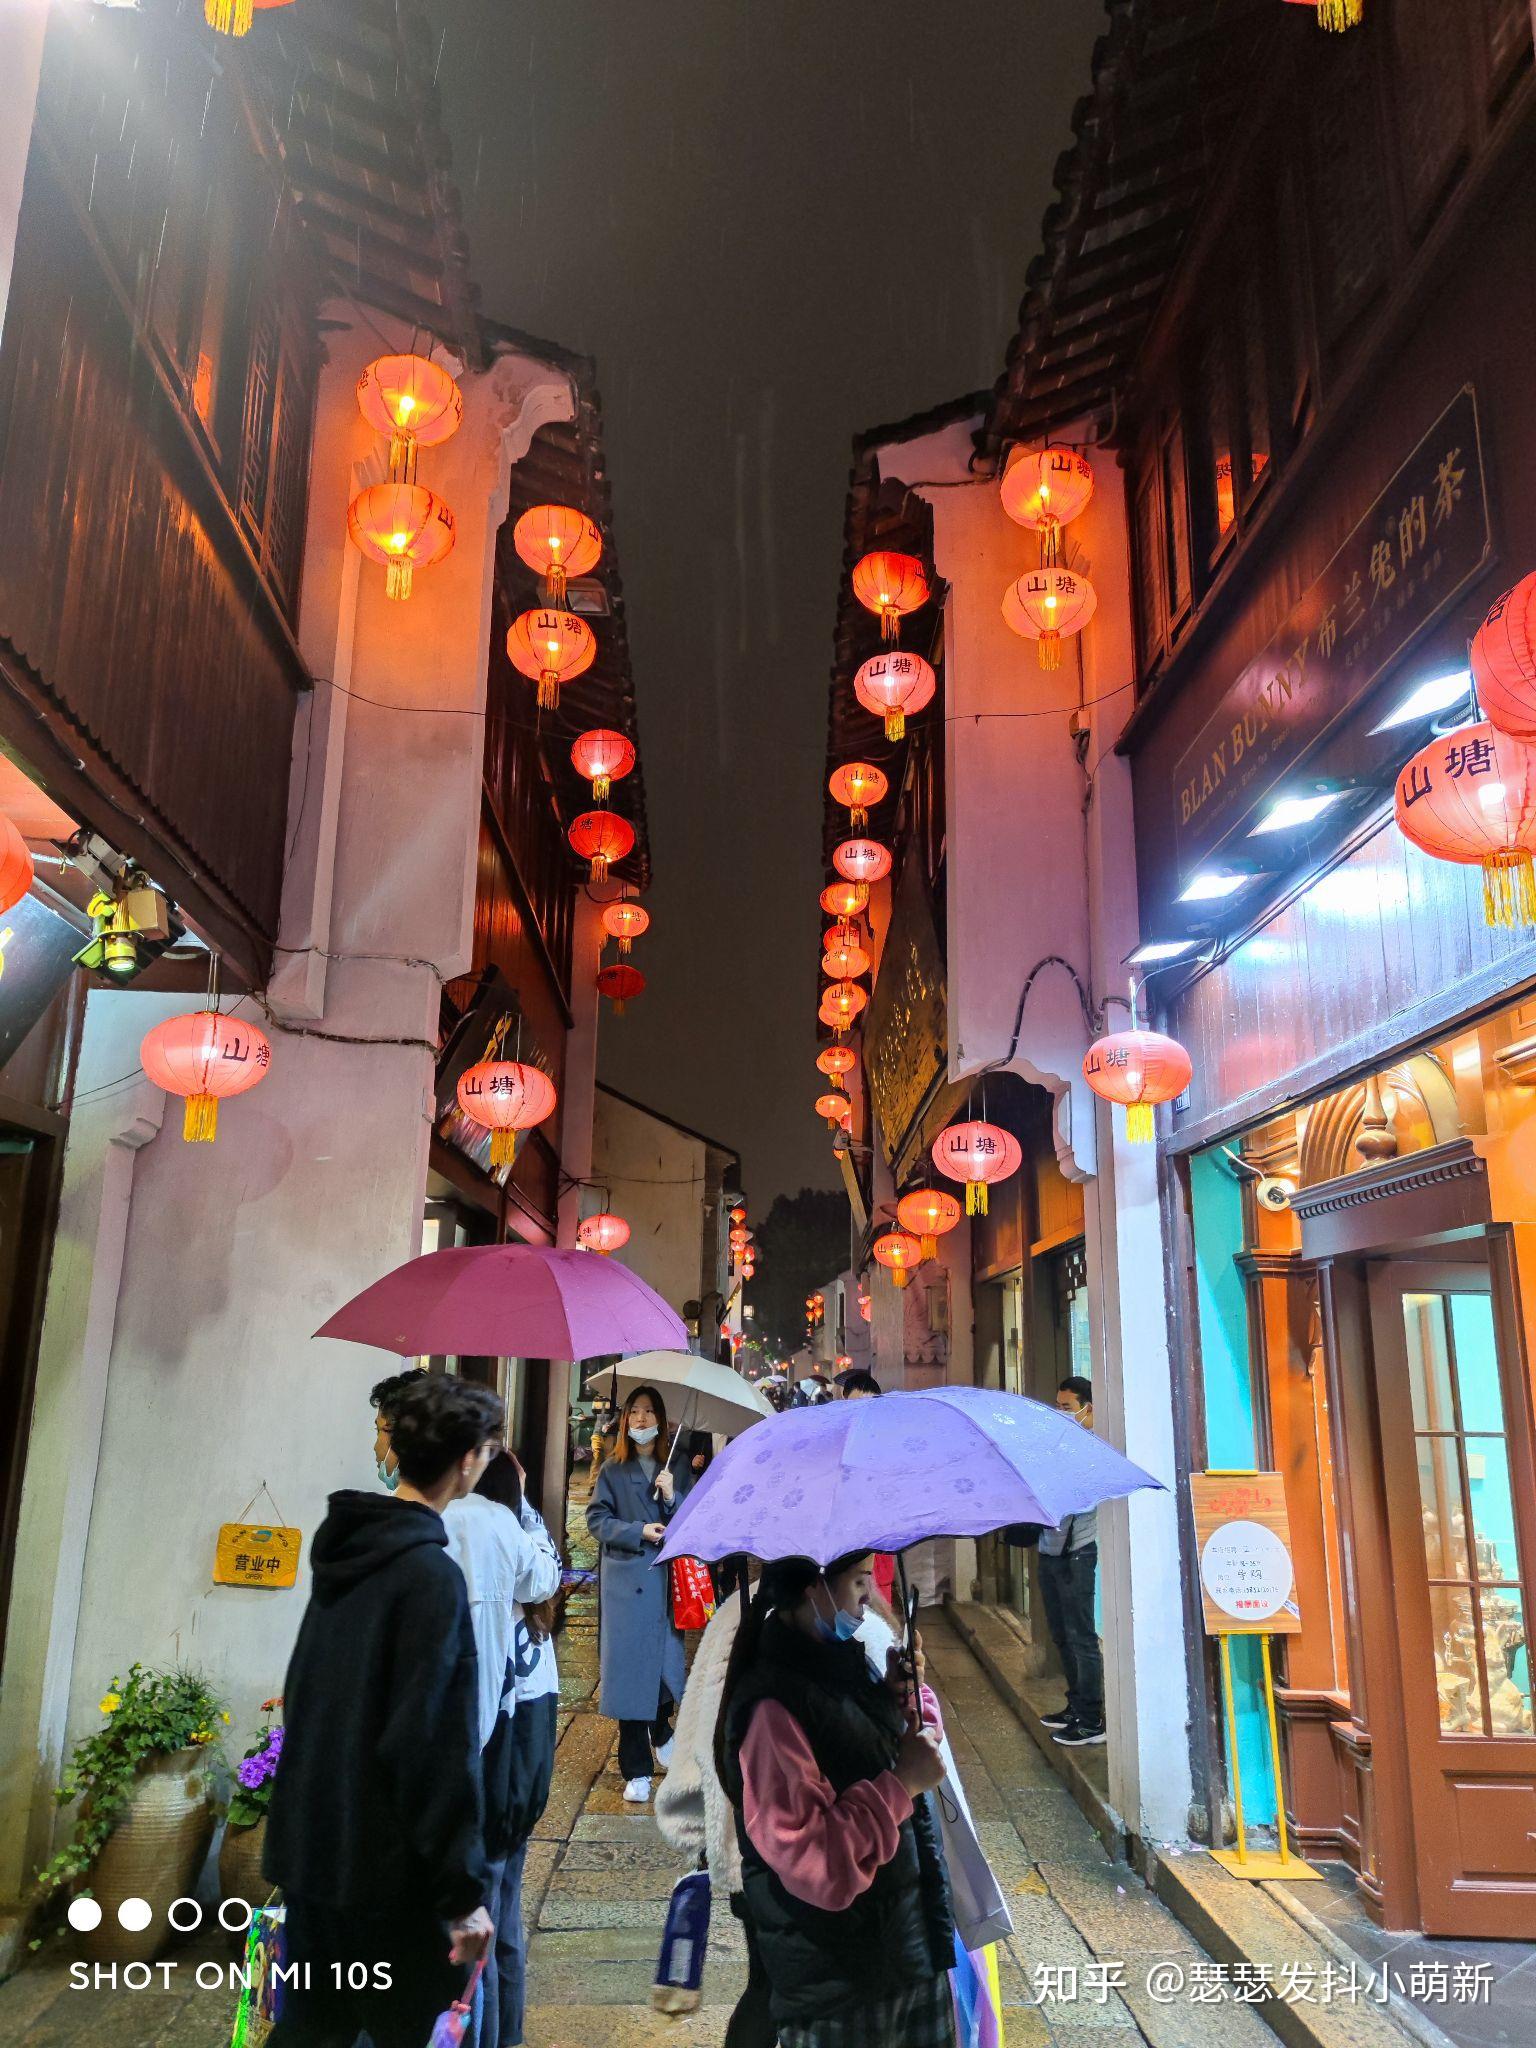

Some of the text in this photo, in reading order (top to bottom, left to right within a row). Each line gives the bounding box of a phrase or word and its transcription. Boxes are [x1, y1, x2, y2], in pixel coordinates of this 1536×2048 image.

[1051, 454, 1091, 478] 山塘
[1317, 447, 1466, 659] 布兰兔的茶
[1027, 575, 1077, 594] 山塘
[537, 612, 582, 635] 山塘
[869, 657, 913, 677] 山塘
[1180, 741, 1227, 826] BLAN
[1230, 636, 1310, 766] BUNNY
[850, 770, 880, 784] 山塘
[1402, 738, 1495, 808] 山塘
[845, 847, 877, 861] 山塘
[222, 1037, 271, 1067] 山塘
[1085, 1047, 1130, 1076] 山塘
[465, 1075, 515, 1096] 山塘
[950, 1135, 997, 1155] 山塘
[235, 1554, 281, 1574] 营业中
